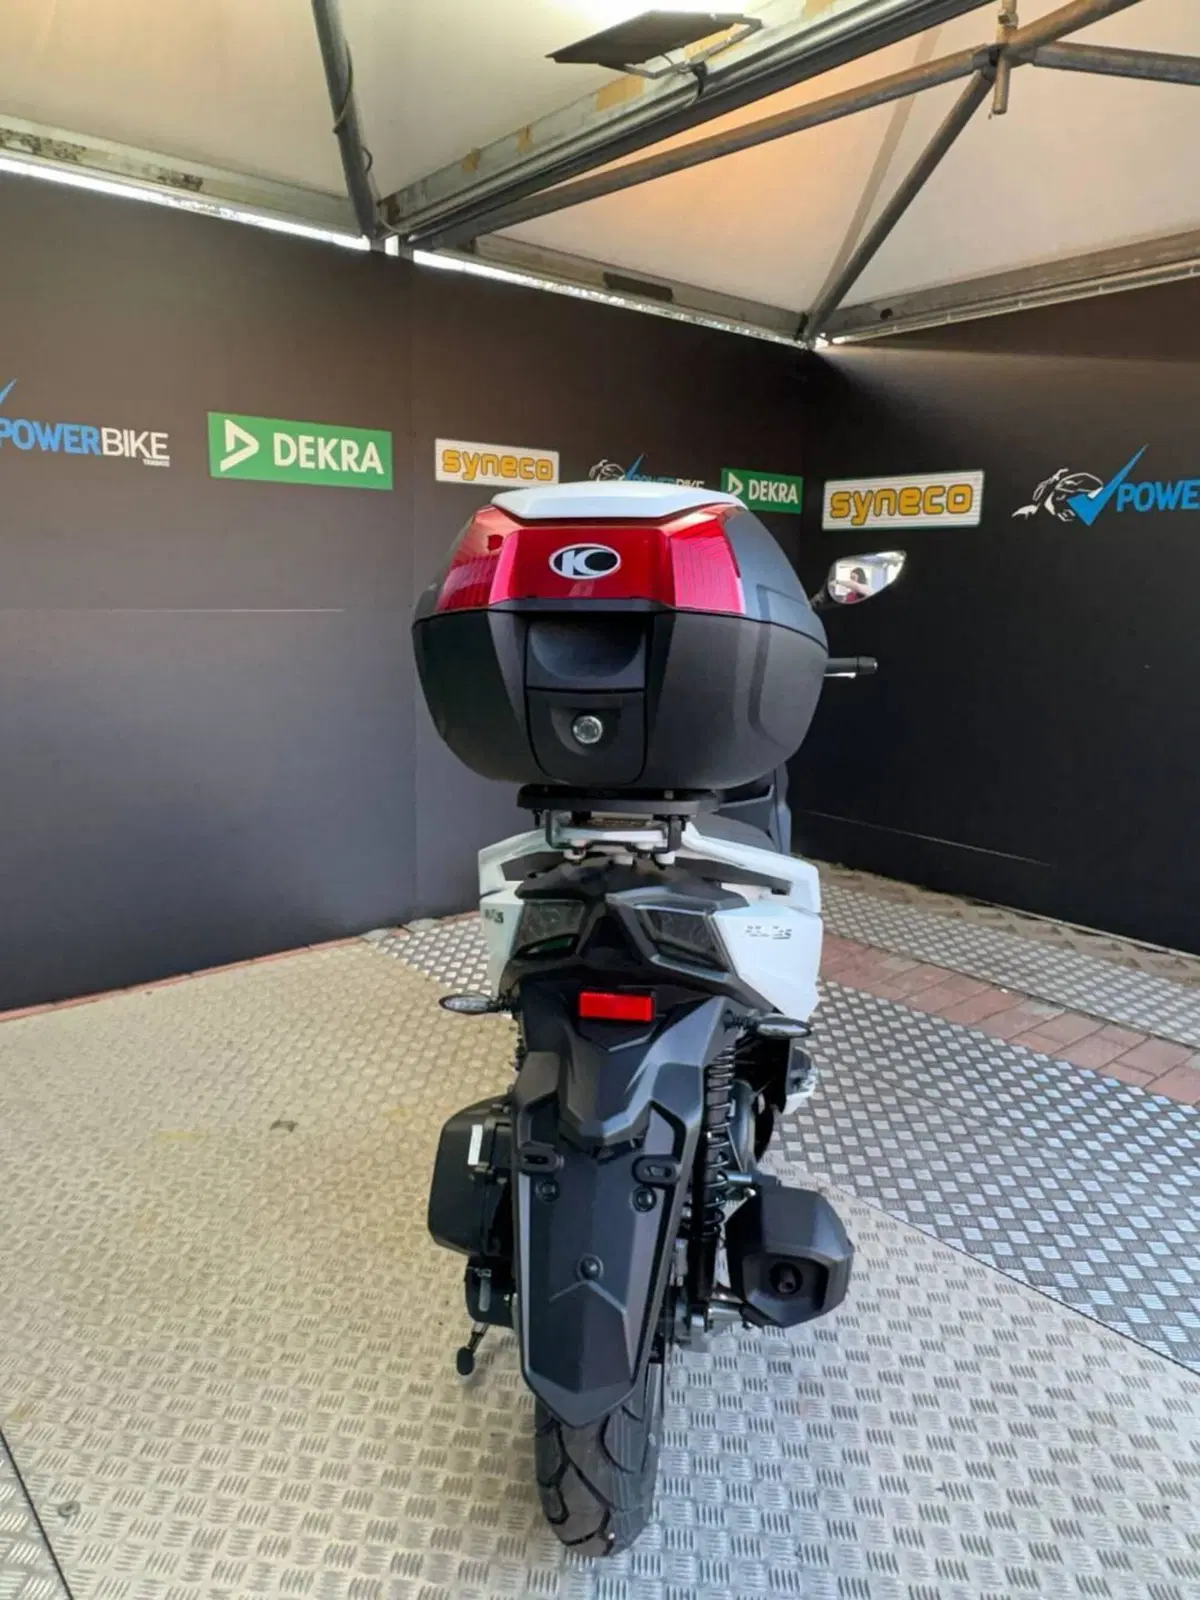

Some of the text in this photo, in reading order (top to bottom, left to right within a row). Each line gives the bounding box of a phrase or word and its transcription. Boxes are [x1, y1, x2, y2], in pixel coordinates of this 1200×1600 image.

[0, 417, 170, 460] POWERBIKE
[273, 432, 384, 475] DEKRA
[442, 449, 554, 481] syneco
[748, 479, 799, 504] DEKRA
[829, 484, 974, 526] syneco
